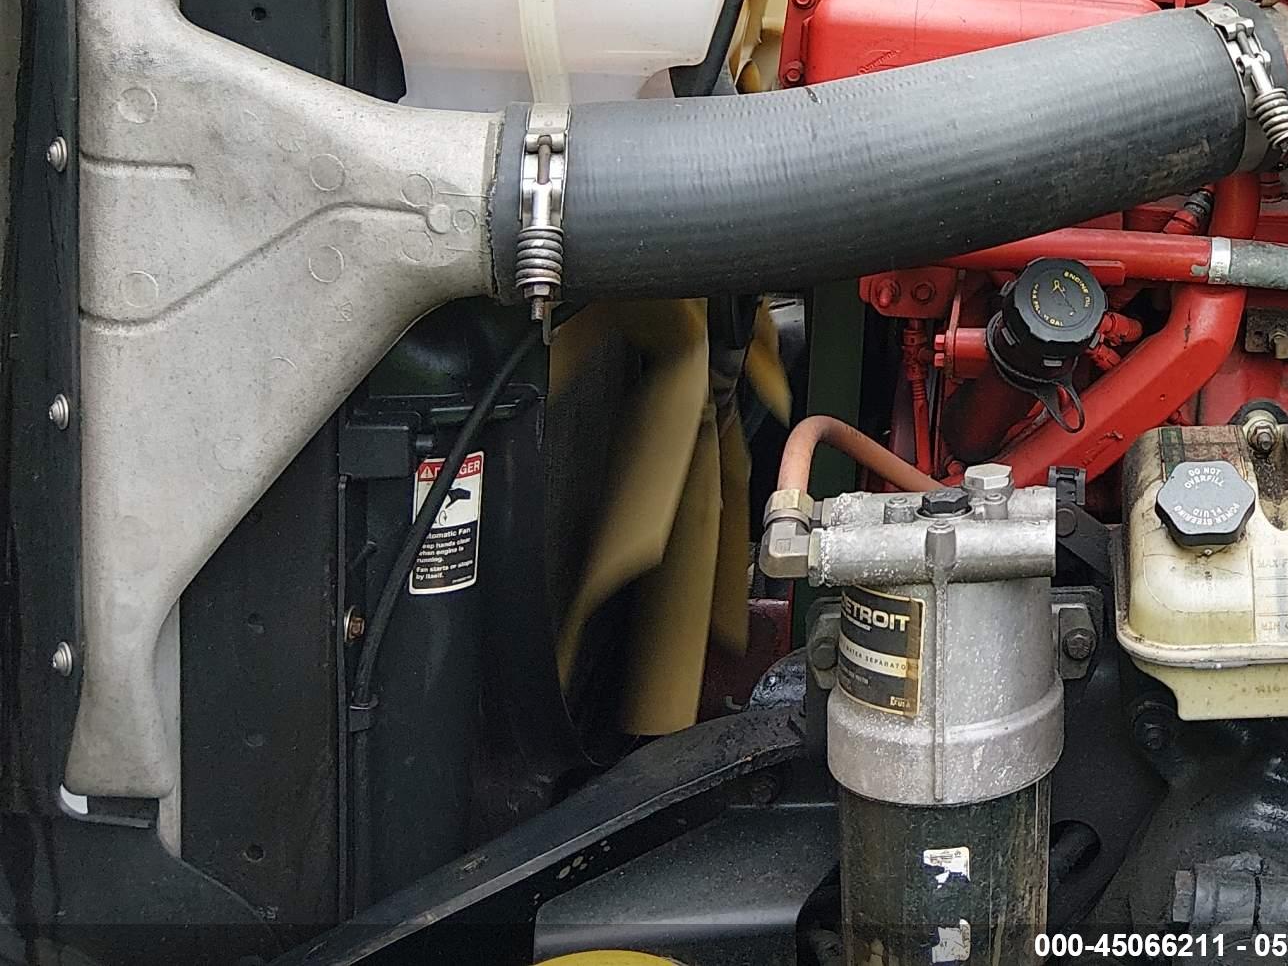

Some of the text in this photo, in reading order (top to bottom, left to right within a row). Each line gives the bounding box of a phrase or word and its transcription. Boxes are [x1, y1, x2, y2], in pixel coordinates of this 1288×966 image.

[1064, 271, 1090, 295] ENGINE
[434, 461, 480, 477] DGER
[1188, 467, 1222, 477] DO NOT
[1184, 475, 1225, 489] OVERFILL
[1174, 505, 1214, 525] STEERING
[1193, 507, 1222, 518] FLUID
[458, 527, 471, 536] Fan
[865, 655, 907, 671] SEPARATO
